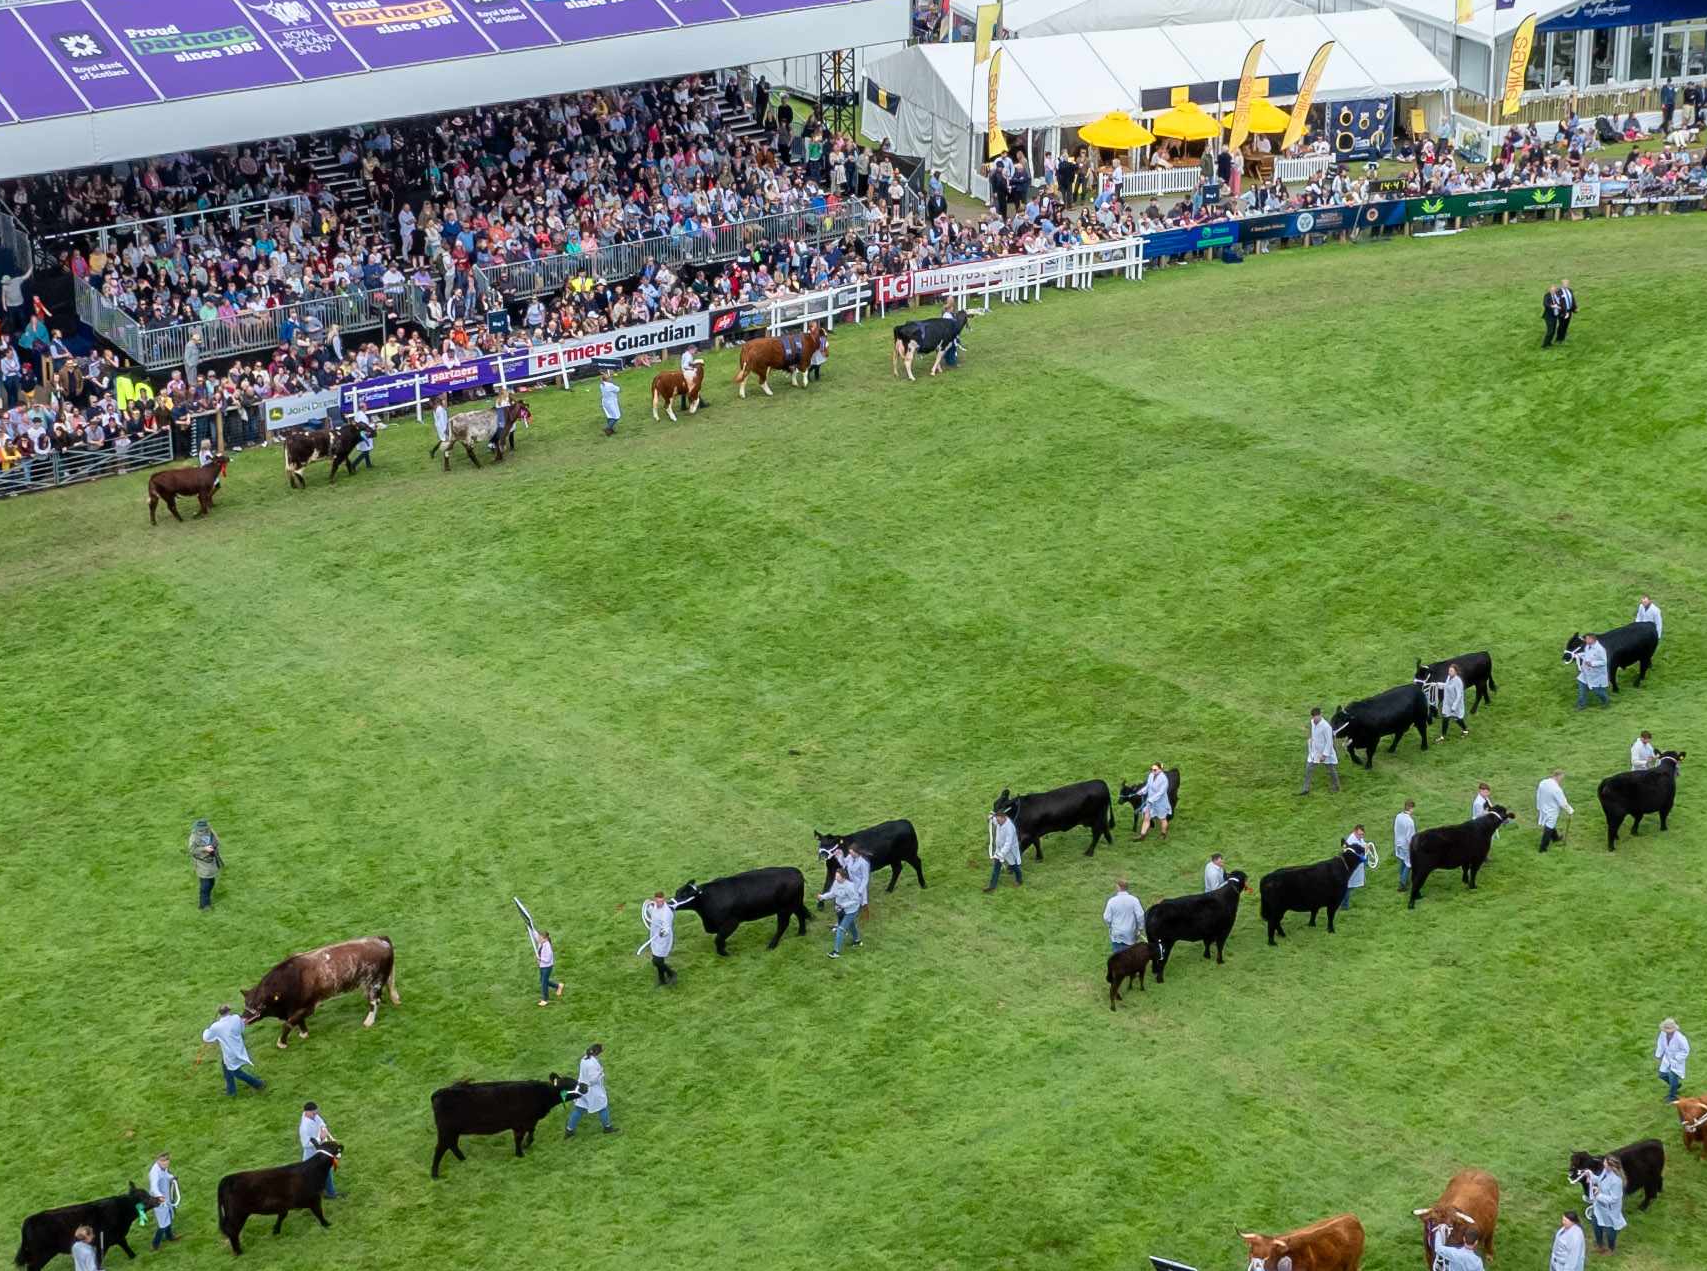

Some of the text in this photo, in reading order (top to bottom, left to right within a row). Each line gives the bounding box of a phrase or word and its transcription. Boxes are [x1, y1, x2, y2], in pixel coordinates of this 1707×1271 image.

[334, 0, 450, 28] partners
[124, 24, 181, 39] Proud
[375, 14, 459, 36] since 1981
[135, 26, 258, 55] partners
[277, 33, 338, 51] HIGHLAND
[283, 27, 319, 42] ROYAL
[174, 41, 263, 63] since 1981
[294, 41, 334, 56] SHOW
[72, 60, 123, 76] Royal Bank
[90, 66, 129, 79] Scotland
[1576, 194, 1596, 202] ARMY
[878, 275, 912, 301] HG
[615, 324, 695, 352] Guardian
[431, 366, 478, 384] partners
[287, 400, 310, 416] JOHN
